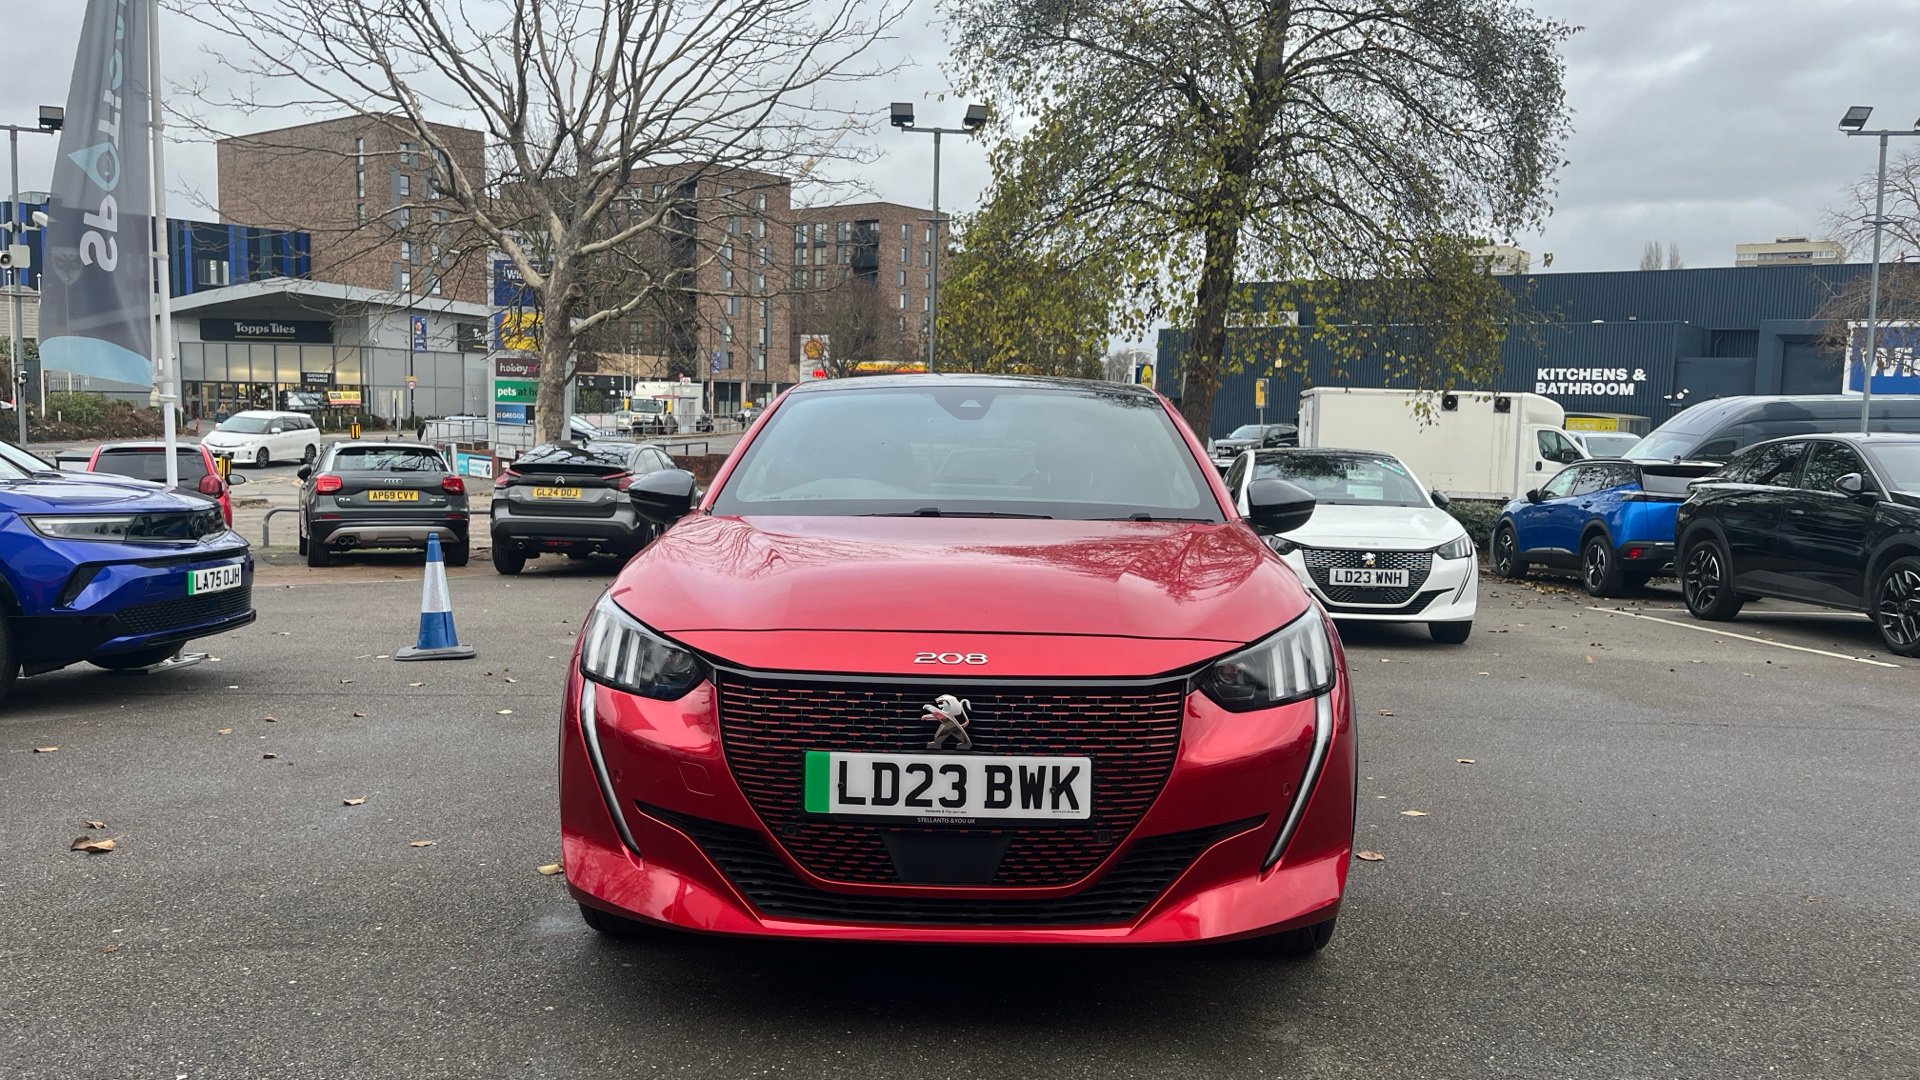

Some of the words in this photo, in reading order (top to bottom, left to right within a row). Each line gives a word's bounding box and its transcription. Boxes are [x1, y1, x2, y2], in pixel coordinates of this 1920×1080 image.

[234, 322, 269, 334] Topps
[270, 323, 296, 333] Tiles
[1537, 368, 1628, 381] KITCHENS
[1632, 368, 1647, 381] &
[498, 387, 517, 397] pets
[518, 387, 527, 396] at
[1535, 382, 1634, 396] BATHROOM
[372, 491, 396, 499] AP69
[397, 491, 414, 499] CVY
[537, 488, 558, 497] GL24
[195, 570, 222, 591] LA75
[223, 561, 240, 586] OJH
[1334, 570, 1371, 584] LD23
[1375, 571, 1402, 584] WNH
[913, 652, 989, 665] 208
[838, 760, 967, 809] LD23
[984, 764, 1081, 810] BWK
